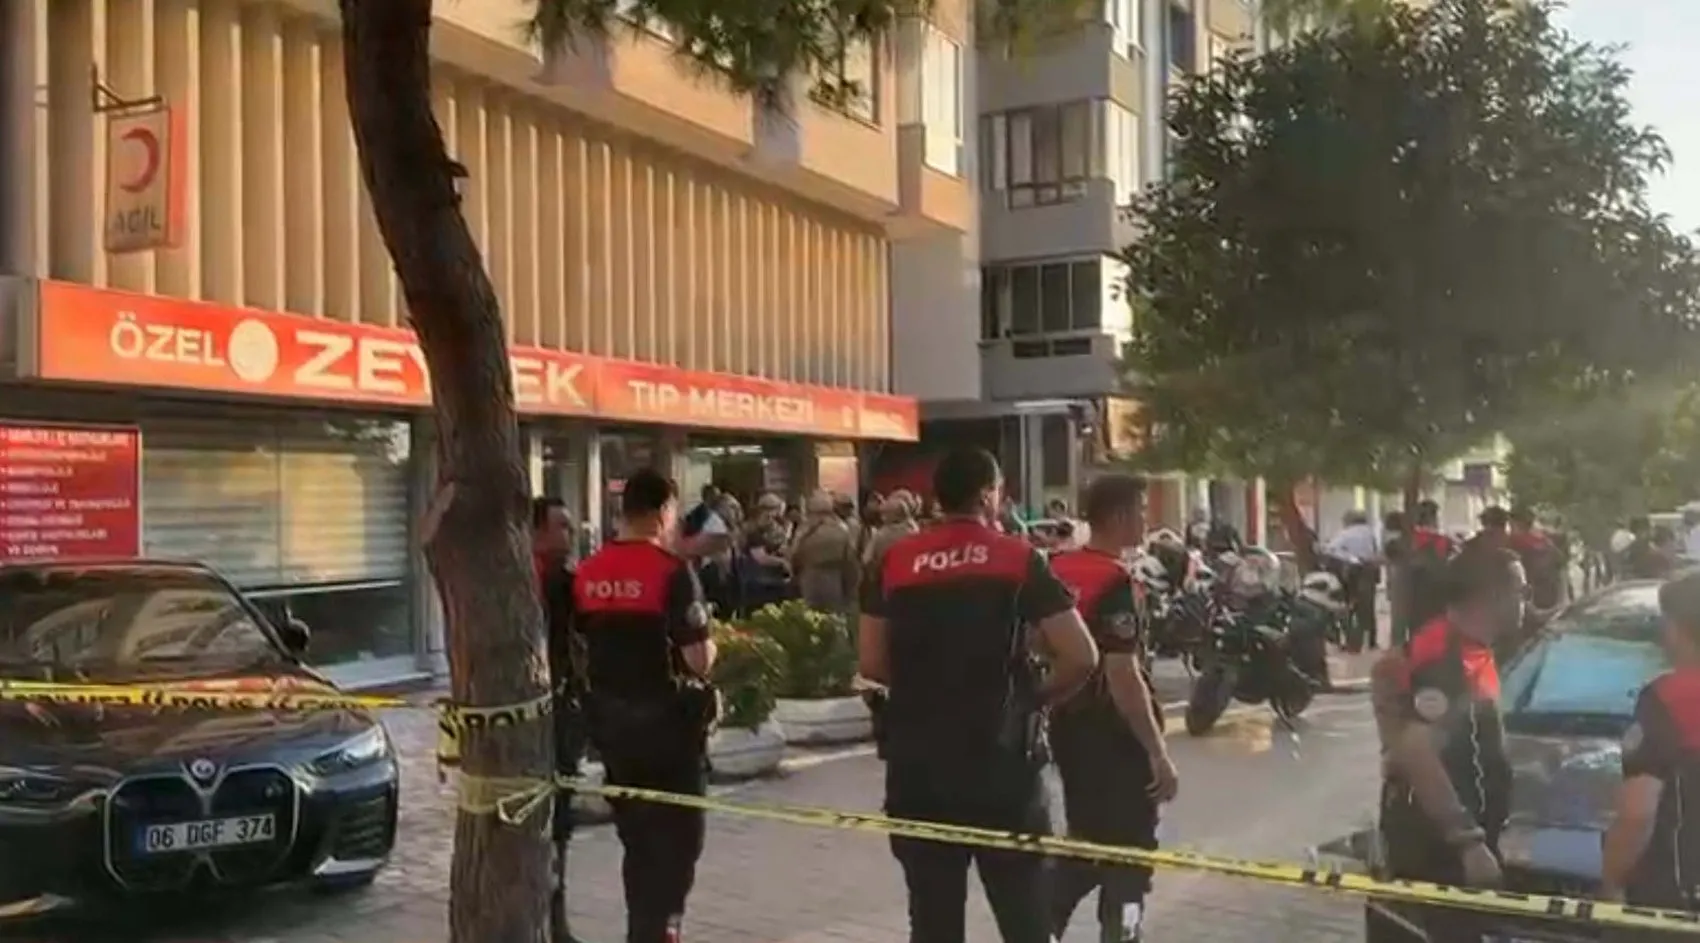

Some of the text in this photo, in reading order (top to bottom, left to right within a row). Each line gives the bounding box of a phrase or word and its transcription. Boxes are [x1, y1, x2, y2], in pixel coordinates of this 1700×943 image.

[110, 311, 225, 366] ÖZEL
[294, 330, 587, 406] ZEYEK
[628, 380, 680, 412] TIP
[150, 827, 175, 849] 06
[236, 816, 273, 840] 374
